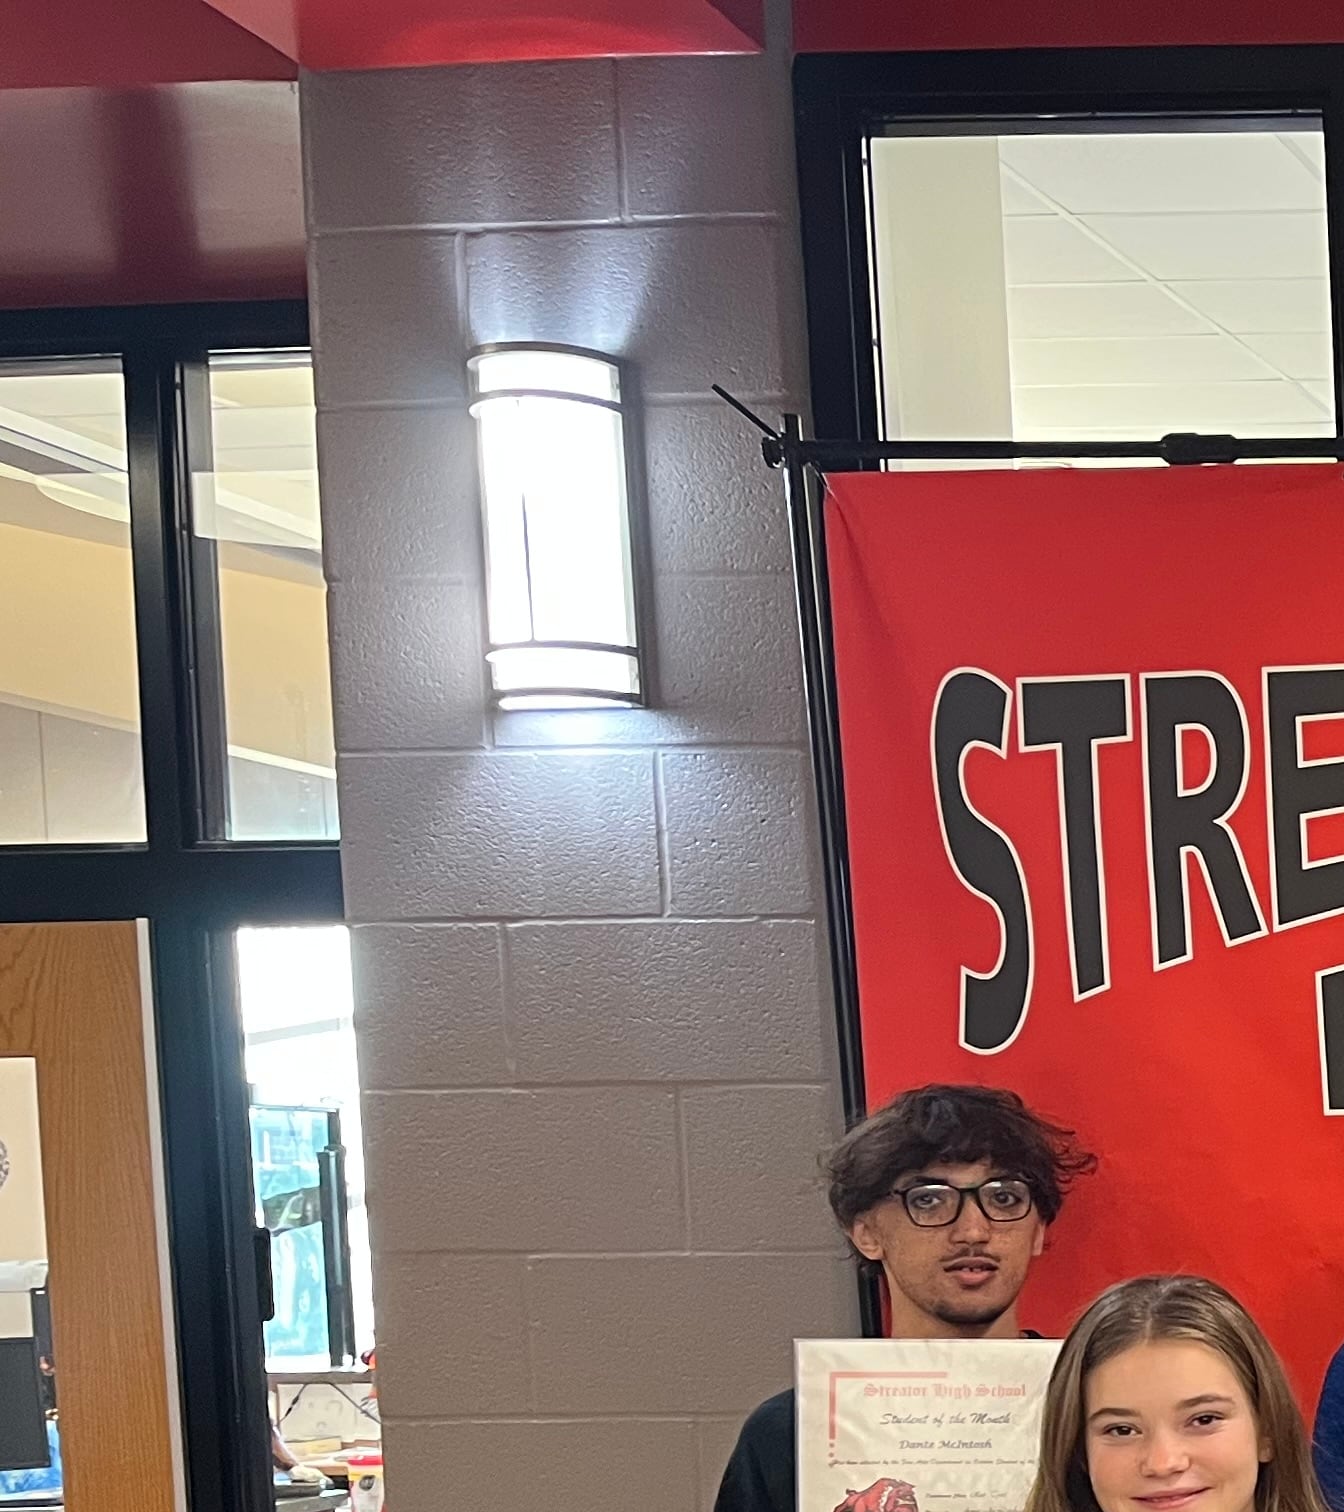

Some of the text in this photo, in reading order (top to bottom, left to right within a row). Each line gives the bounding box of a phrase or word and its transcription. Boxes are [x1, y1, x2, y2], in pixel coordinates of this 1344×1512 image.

[864, 1384, 1026, 1399] Streator High School
[880, 1413, 1011, 1427] Student of the Month
[900, 1439, 992, 1448] Dante McIntosh
